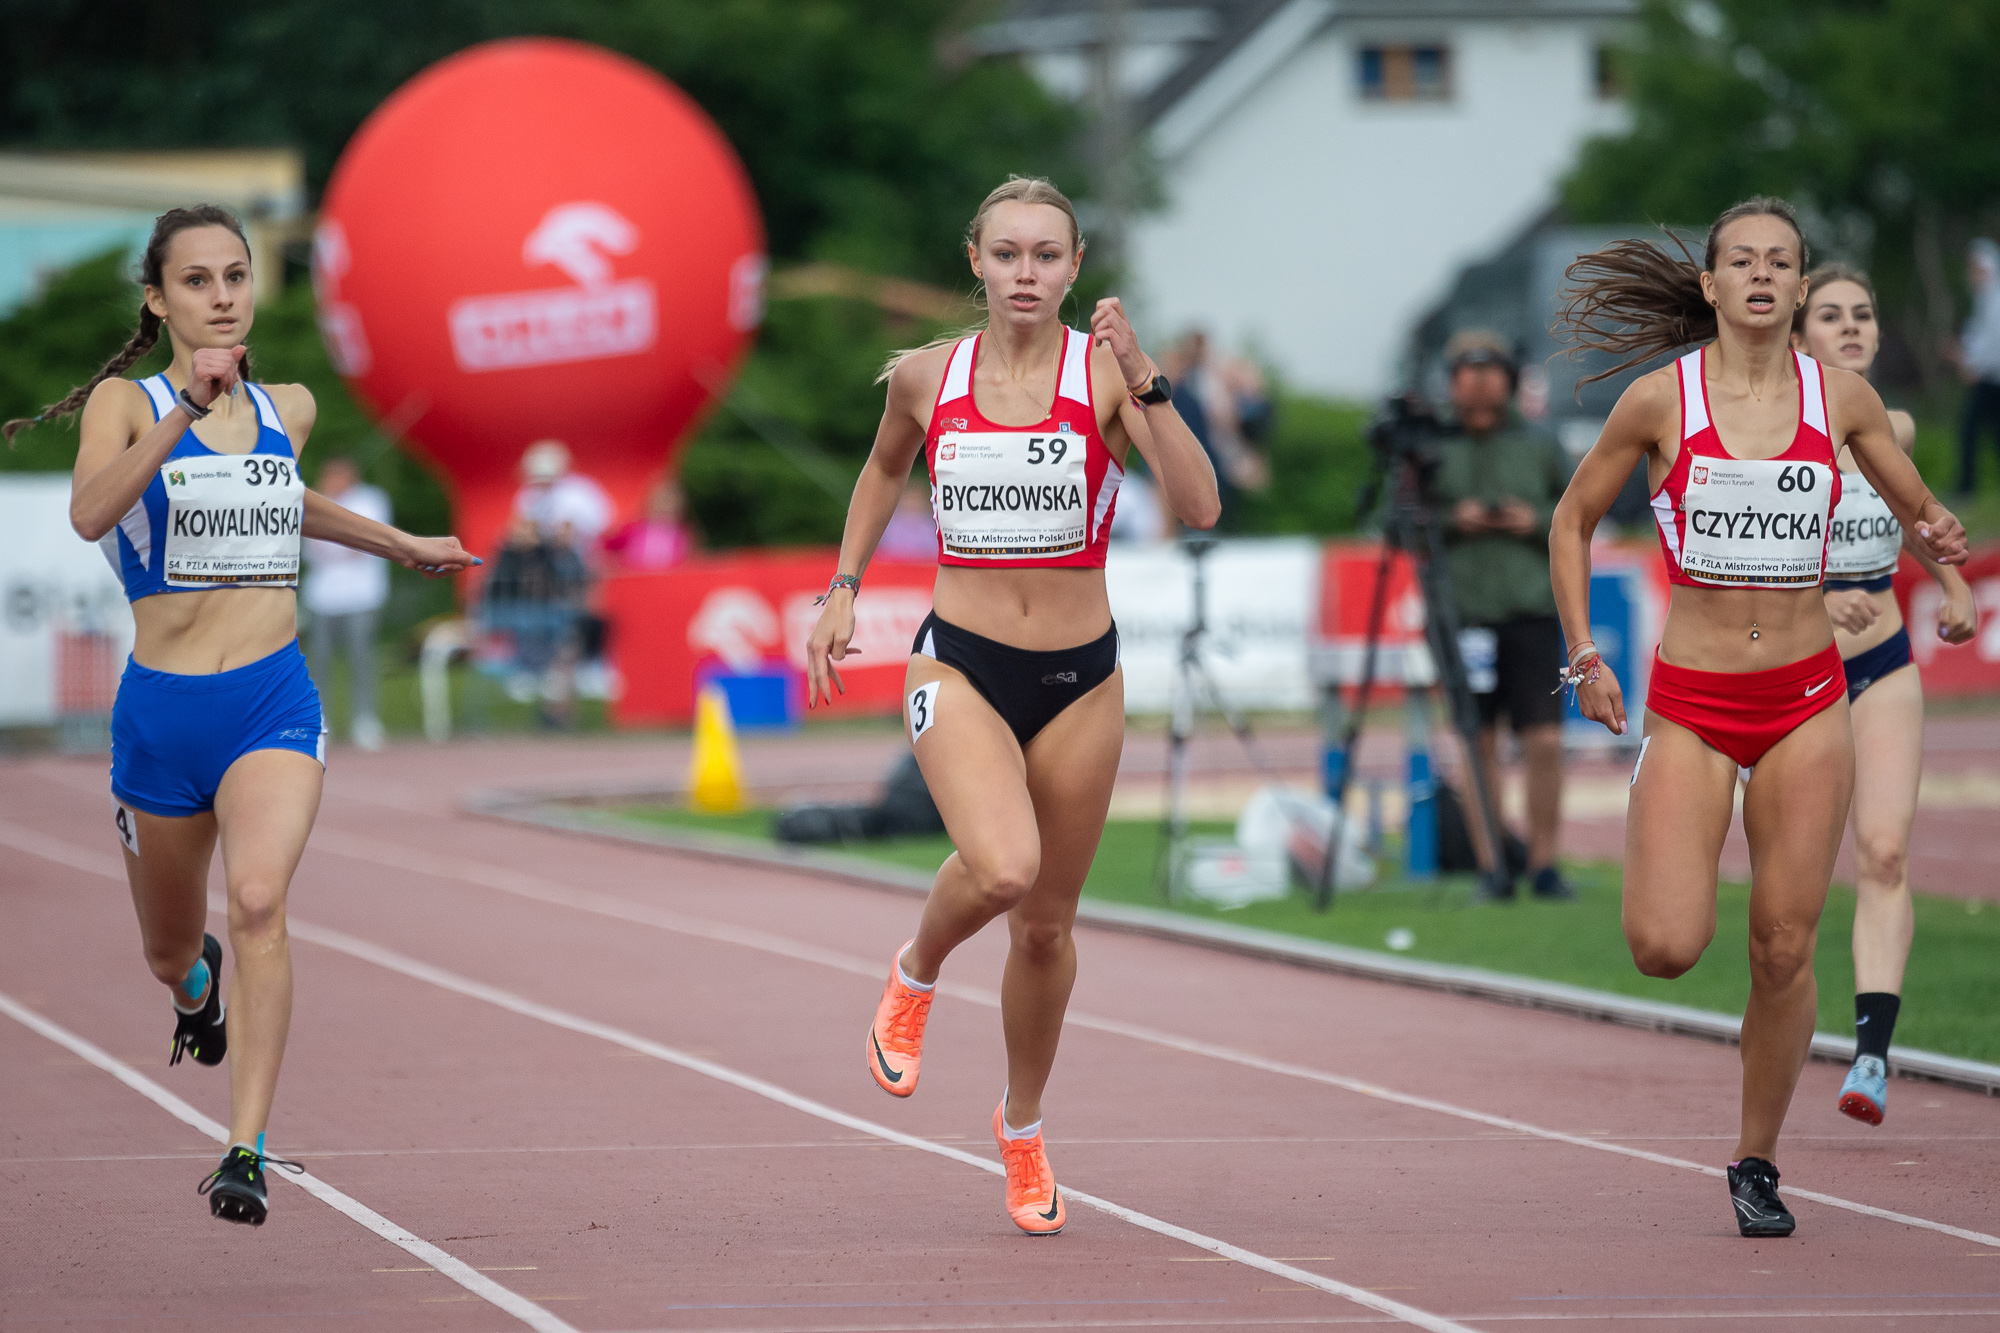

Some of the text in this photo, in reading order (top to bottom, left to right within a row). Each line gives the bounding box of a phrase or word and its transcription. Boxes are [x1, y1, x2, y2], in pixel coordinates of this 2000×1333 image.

[940, 417, 968, 430] esa
[1027, 438, 1068, 465] 59
[190, 471, 232, 480] Bielsko-Biała
[243, 459, 291, 487] 399
[1711, 471, 1744, 479] Ministerstwo
[1777, 465, 1816, 493] 60
[942, 484, 1082, 512] BYCZKOWSKA
[173, 501, 299, 538] KOWALIŃSKA
[1692, 505, 1821, 540] CZYŻYCKA
[944, 529, 1084, 543] 54. PZLA Mistrzostwa Polski U18
[168, 560, 183, 569] 54.
[186, 561, 209, 570] PZLA
[212, 561, 265, 571] Mistrzostwa
[267, 560, 290, 570] Polski
[1684, 555, 1698, 566] 54.
[1700, 558, 1722, 570] PZLA
[1724, 562, 1779, 572] Mistrzostwa
[1781, 562, 1806, 572] Polski
[1807, 561, 1820, 571] U18
[170, 574, 237, 582] BIELSKO-BIAŁA
[1686, 569, 1749, 582] BIELSKO-BIAŁA
[913, 689, 927, 733] 3
[115, 806, 132, 846] 4
